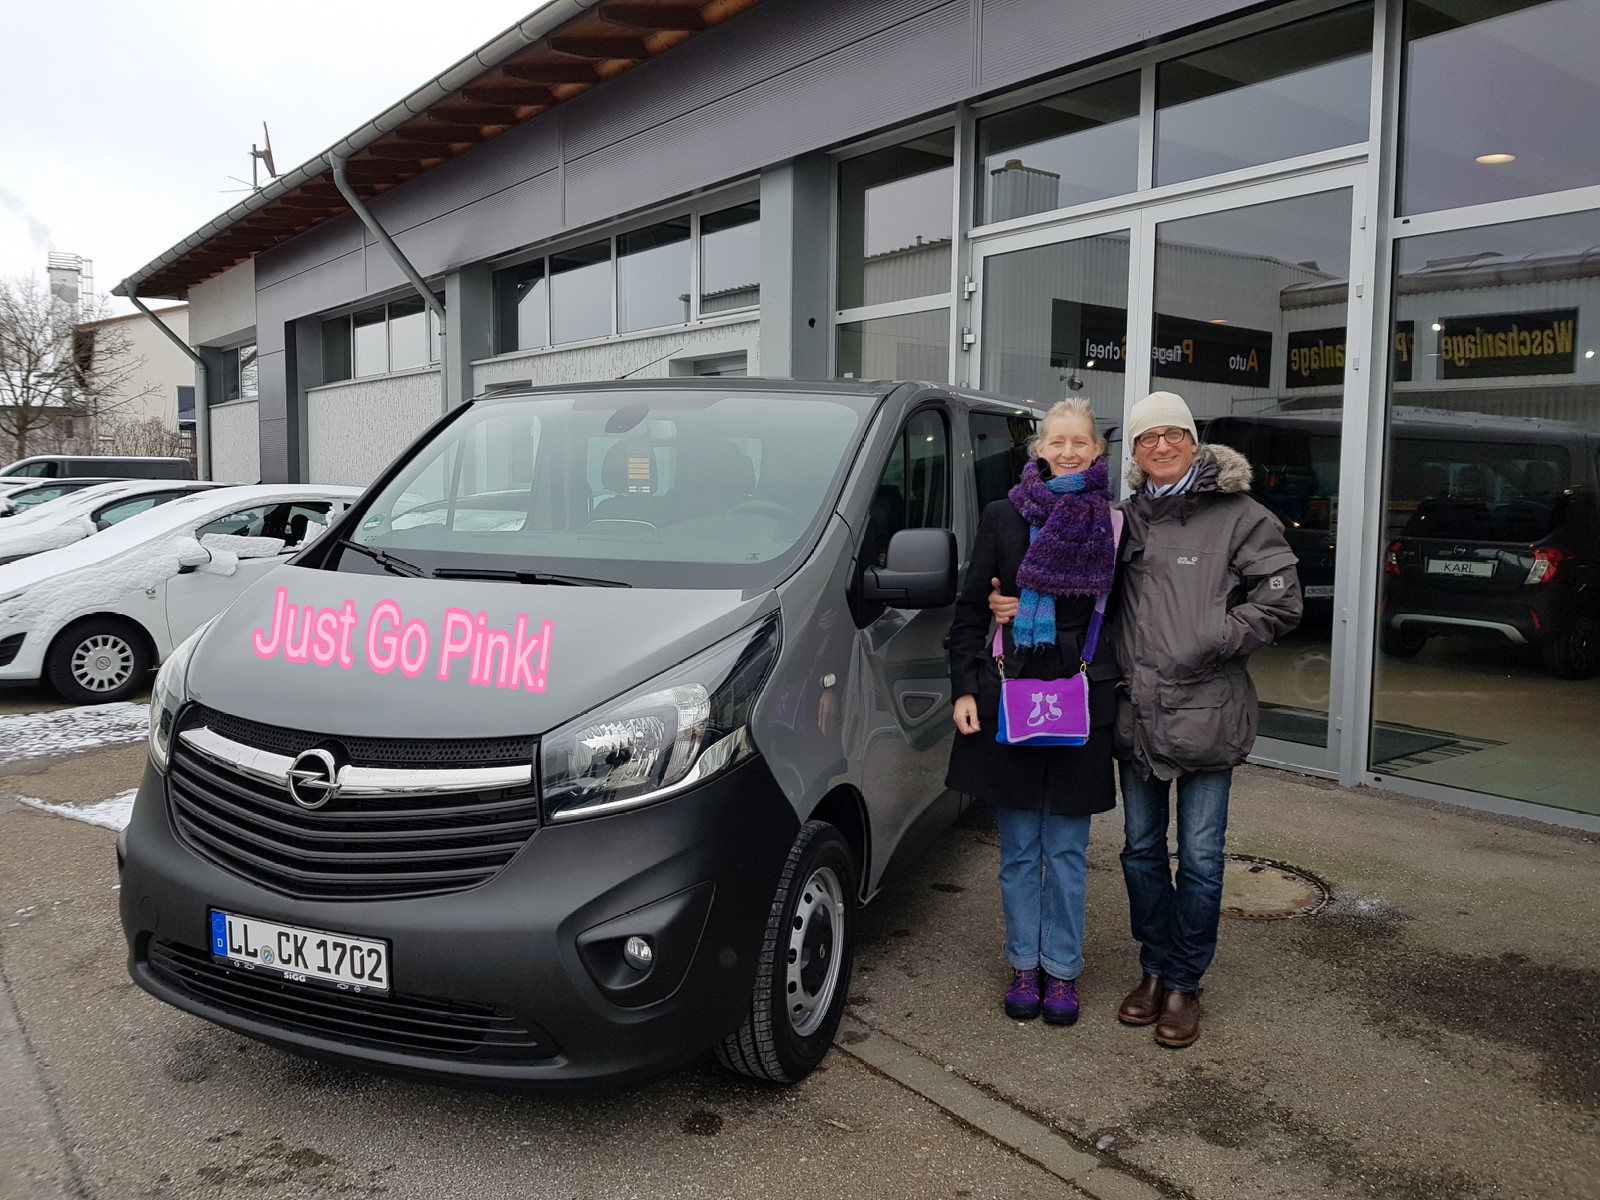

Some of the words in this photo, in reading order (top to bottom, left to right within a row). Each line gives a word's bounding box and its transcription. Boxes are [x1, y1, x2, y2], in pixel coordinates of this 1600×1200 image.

[1443, 561, 1475, 574] KARL
[228, 920, 258, 958] LL
[277, 931, 309, 969] CK
[316, 939, 383, 983] 1702
